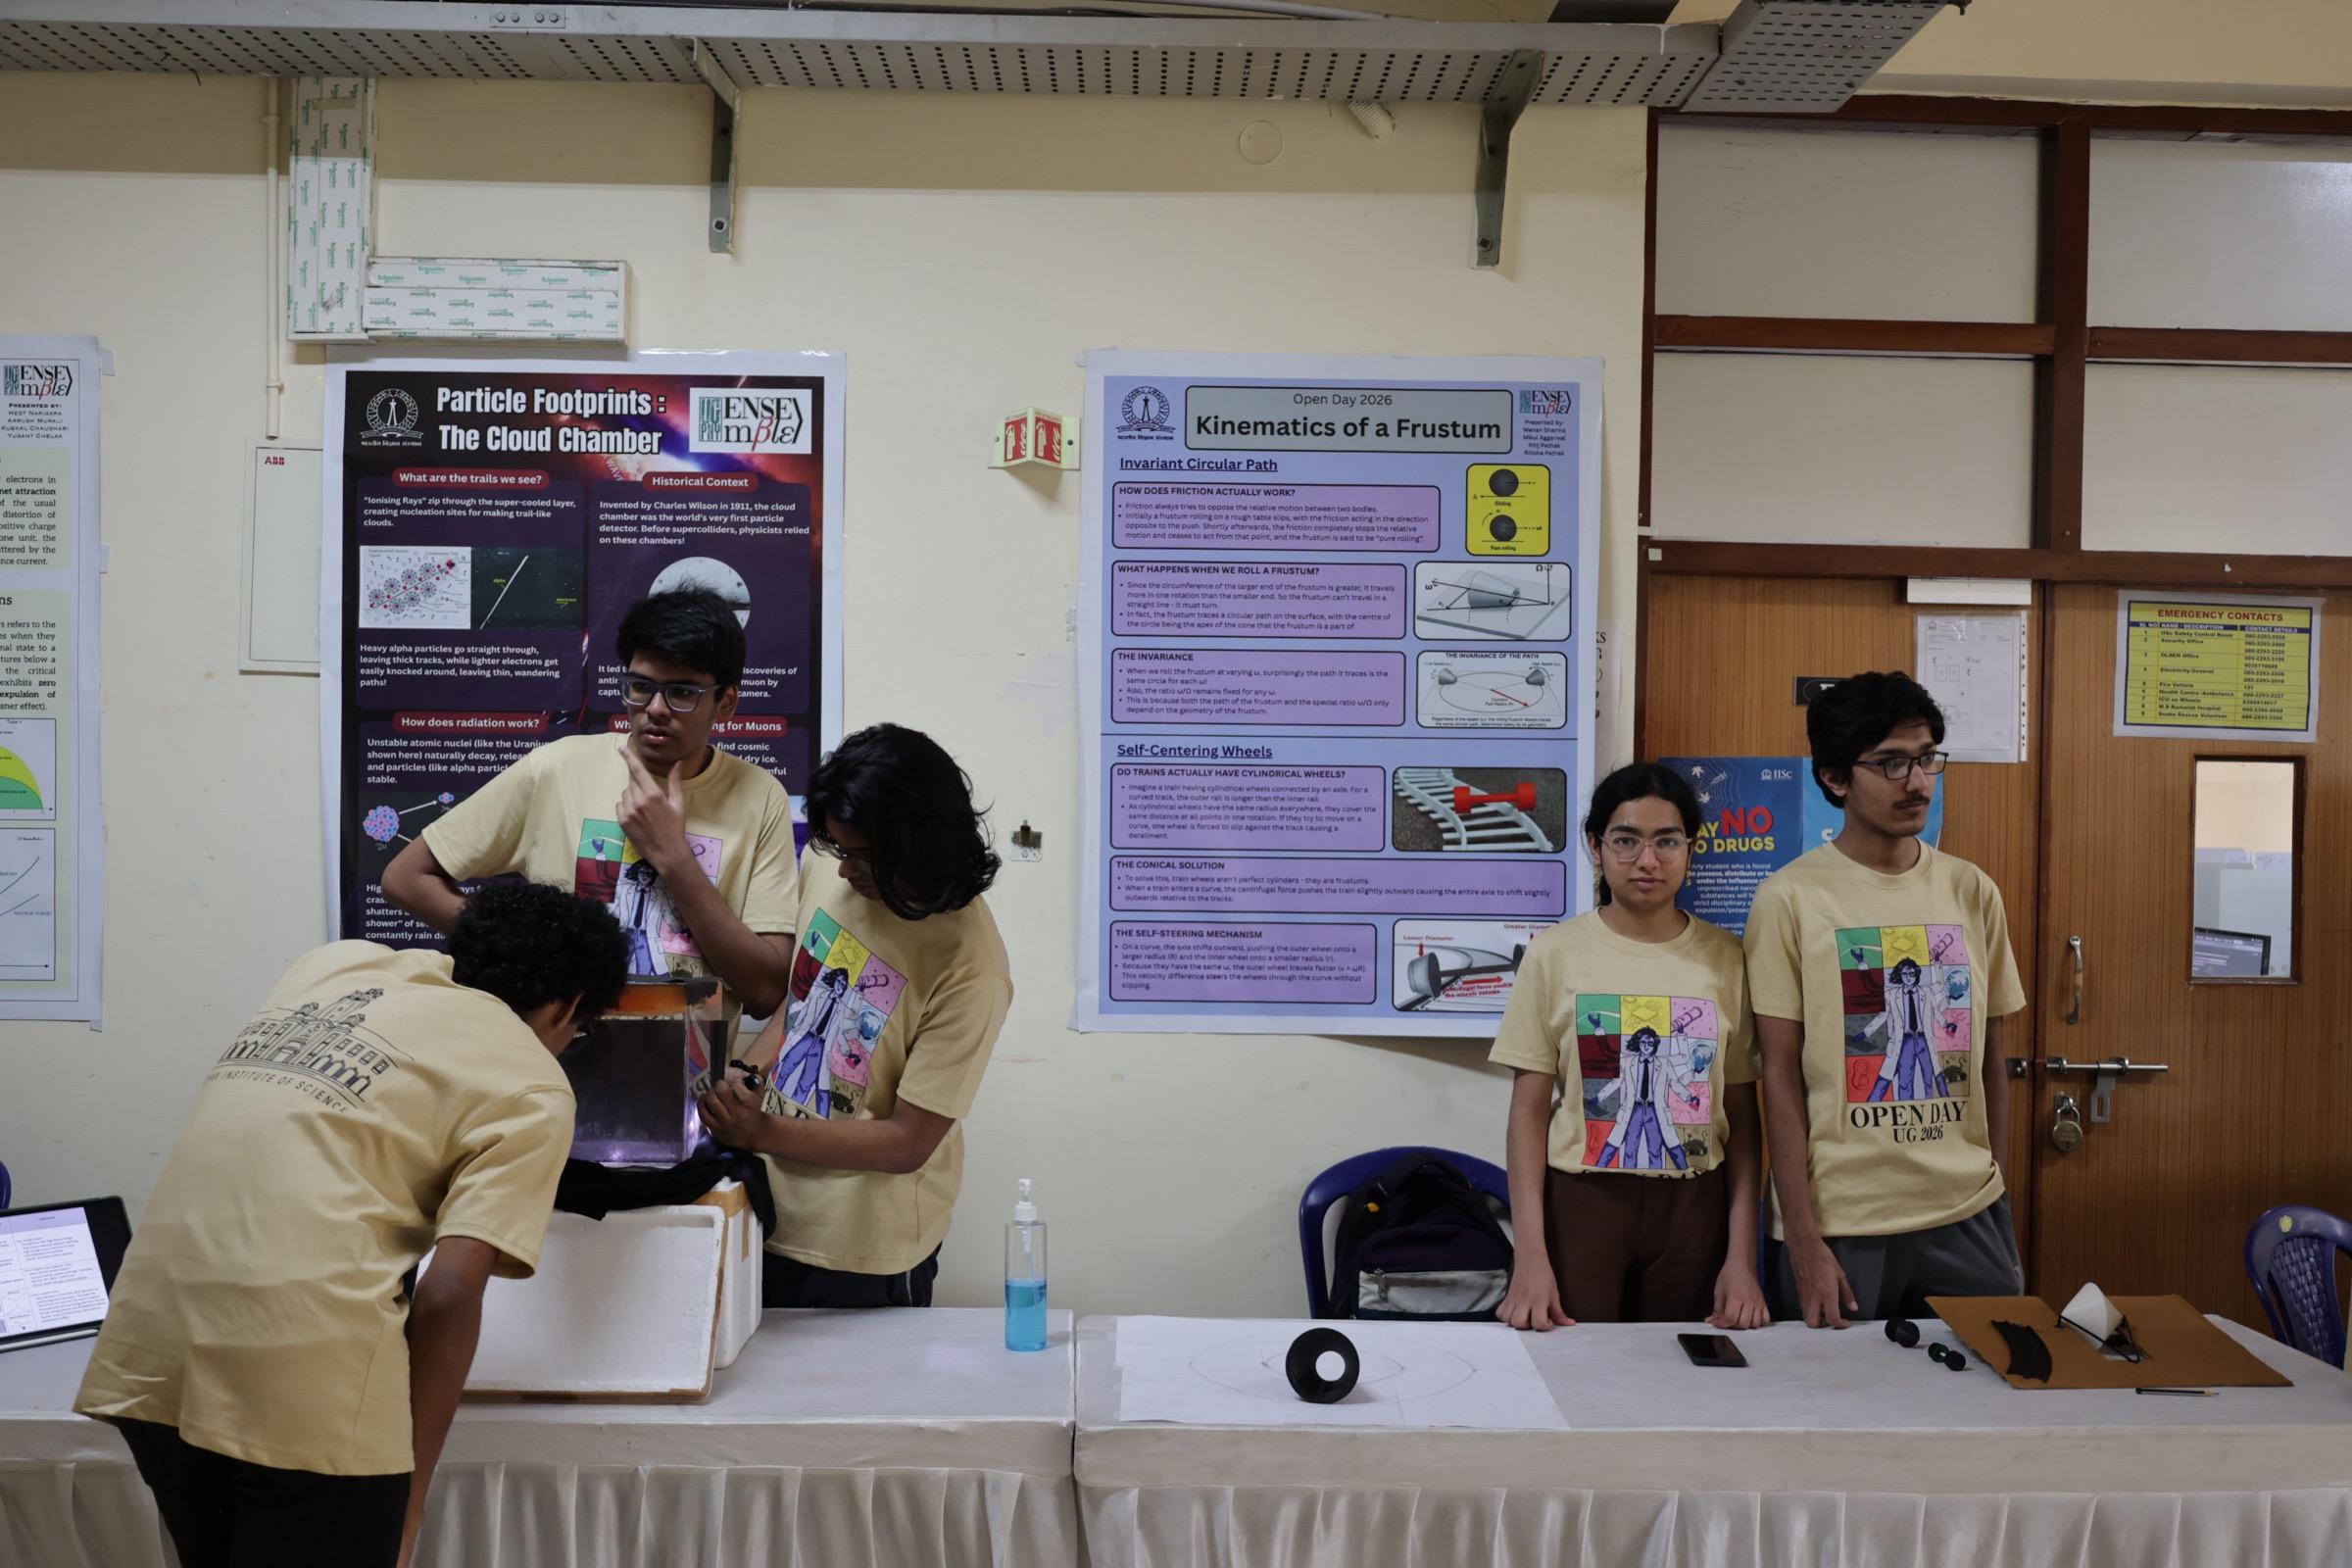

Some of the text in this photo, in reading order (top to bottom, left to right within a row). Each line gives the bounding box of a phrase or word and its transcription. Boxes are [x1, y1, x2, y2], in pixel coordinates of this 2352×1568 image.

[437, 387, 526, 414] Particle
[534, 389, 651, 418] Footprints
[1294, 393, 1392, 407] Open Day 2026
[1197, 416, 1500, 438] Kinematics of a Frustum
[438, 424, 662, 454] The Cloud Chamber
[265, 456, 284, 465] ABB
[1120, 458, 1277, 470] Invariant Circular Path
[400, 472, 426, 481] What
[449, 473, 467, 482] the
[469, 474, 498, 483] trails
[653, 476, 748, 486] Historical Context
[402, 497, 426, 506] Rays"
[428, 497, 440, 506] zip
[442, 497, 476, 507] through
[494, 499, 551, 508] super-cooled
[641, 501, 652, 511] by
[364, 508, 398, 516] creating
[483, 510, 514, 518] making
[750, 514, 784, 523] particle
[28, 523, 56, 532] charge
[2158, 610, 2283, 621] EMERGENCY CONTACTS
[36, 632, 56, 642] they
[20, 702, 46, 711] effect).
[402, 717, 539, 727] How does radiation work?
[727, 721, 781, 730] for Muons
[1117, 745, 1272, 759] Self-Centering Wheels
[1242, 769, 1301, 778] CYLINDRICAL
[1773, 769, 1792, 779] IISc
[1696, 807, 1773, 838] AY NO
[1714, 837, 1775, 853] DRUGS
[366, 931, 413, 941] constantly
[221, 1070, 275, 1083] INSTITUTE
[277, 1076, 293, 1087] OF
[296, 1081, 348, 1112] SCIENCE
[1851, 1101, 1968, 1129] OPEN DAY
[1893, 1125, 1943, 1143] UG 2026
